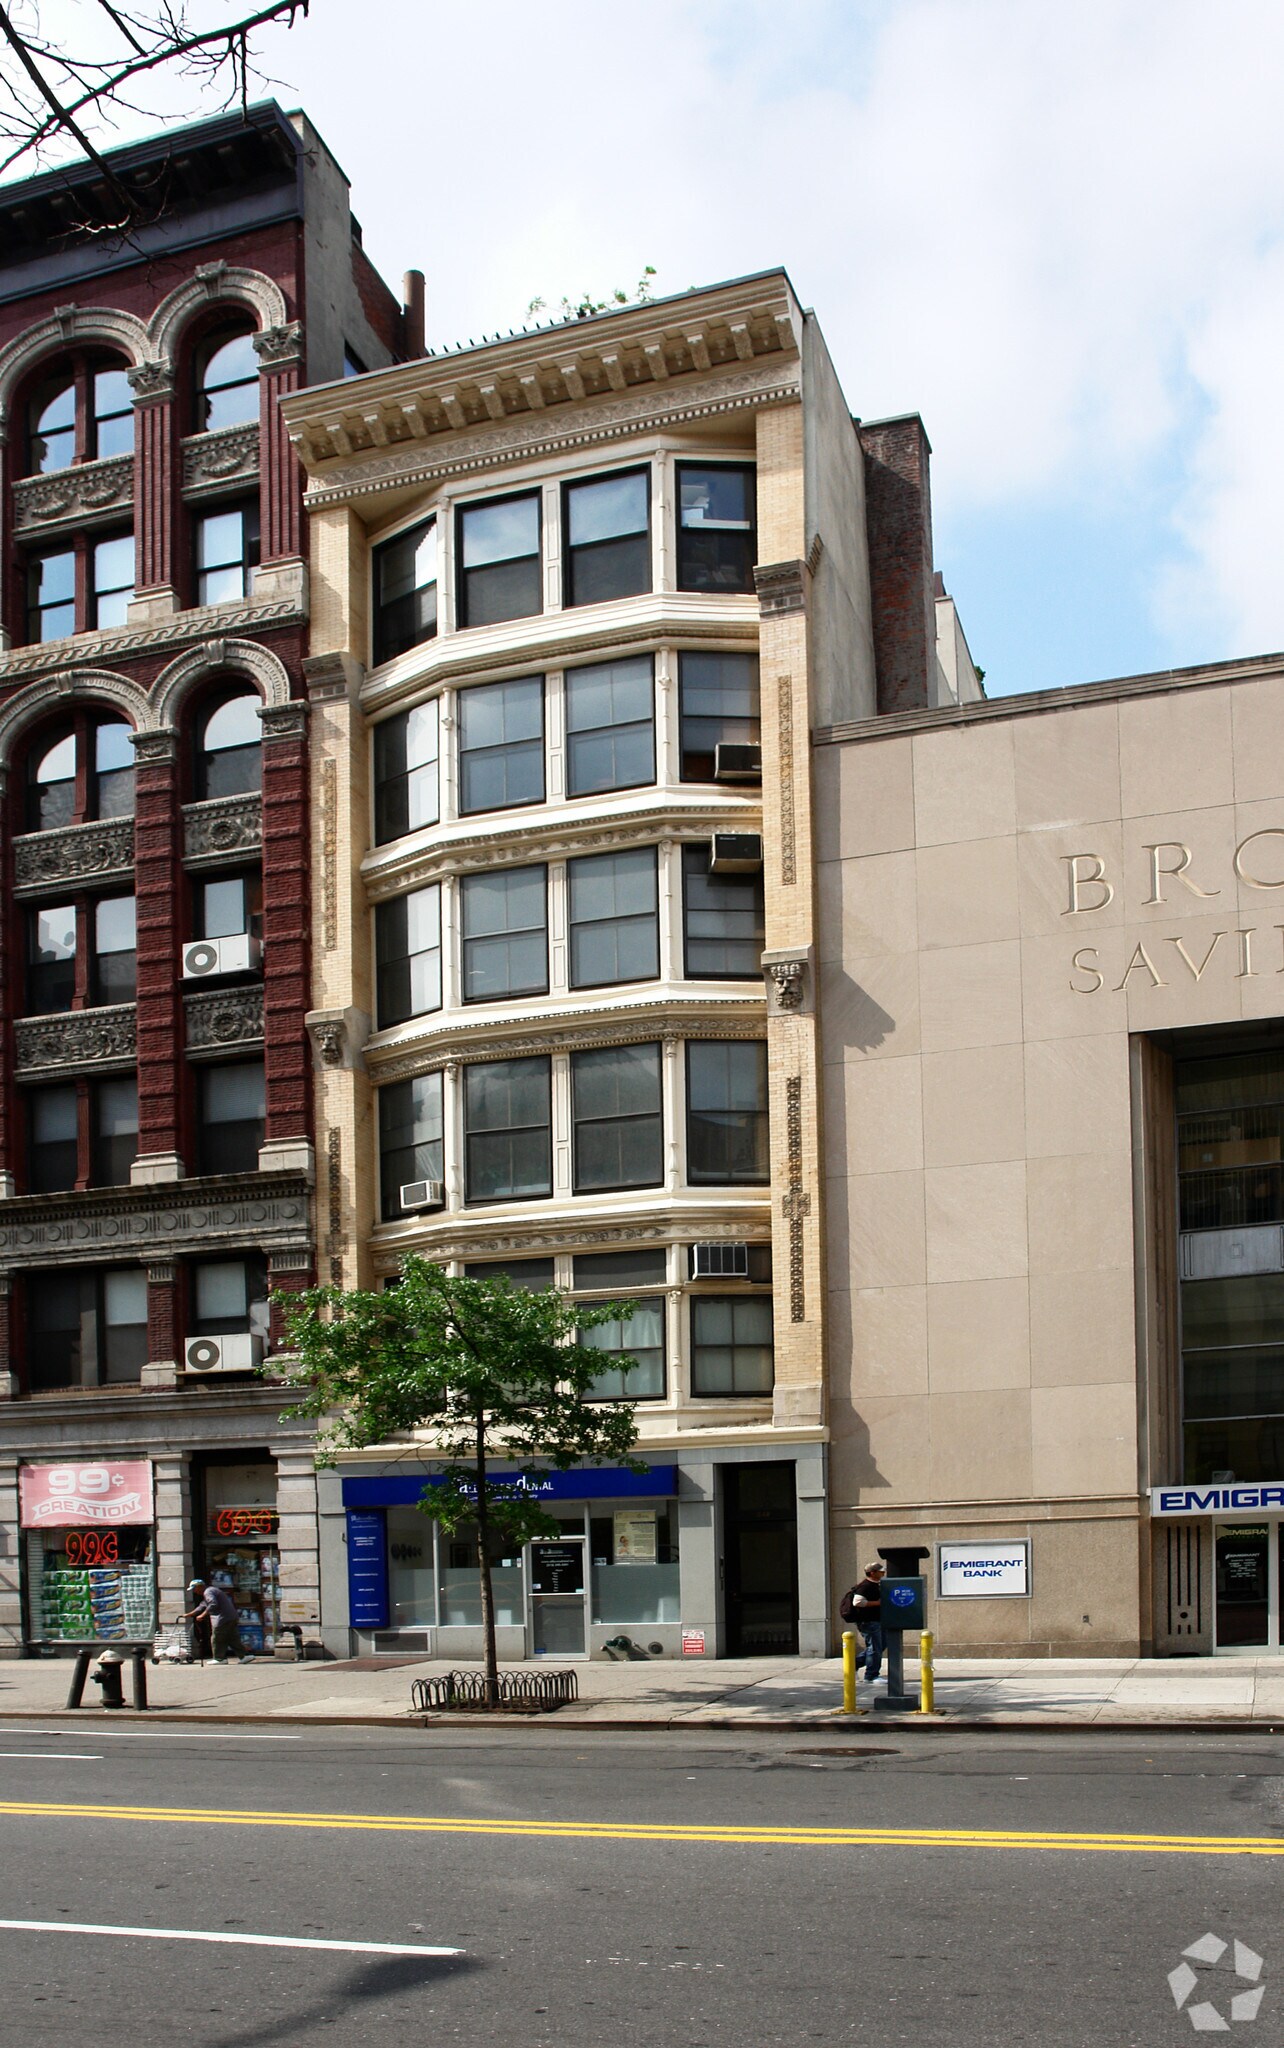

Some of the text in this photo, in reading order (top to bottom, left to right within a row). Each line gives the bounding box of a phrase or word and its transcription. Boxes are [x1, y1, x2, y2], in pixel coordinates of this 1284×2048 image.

[1069, 924, 1284, 994] SAVI
[1160, 1487, 1284, 1511] EMIGR
[39, 1500, 136, 1518] CREATION
[950, 1559, 1023, 1569] EMIGRANT
[963, 1569, 1002, 1578] BANK
